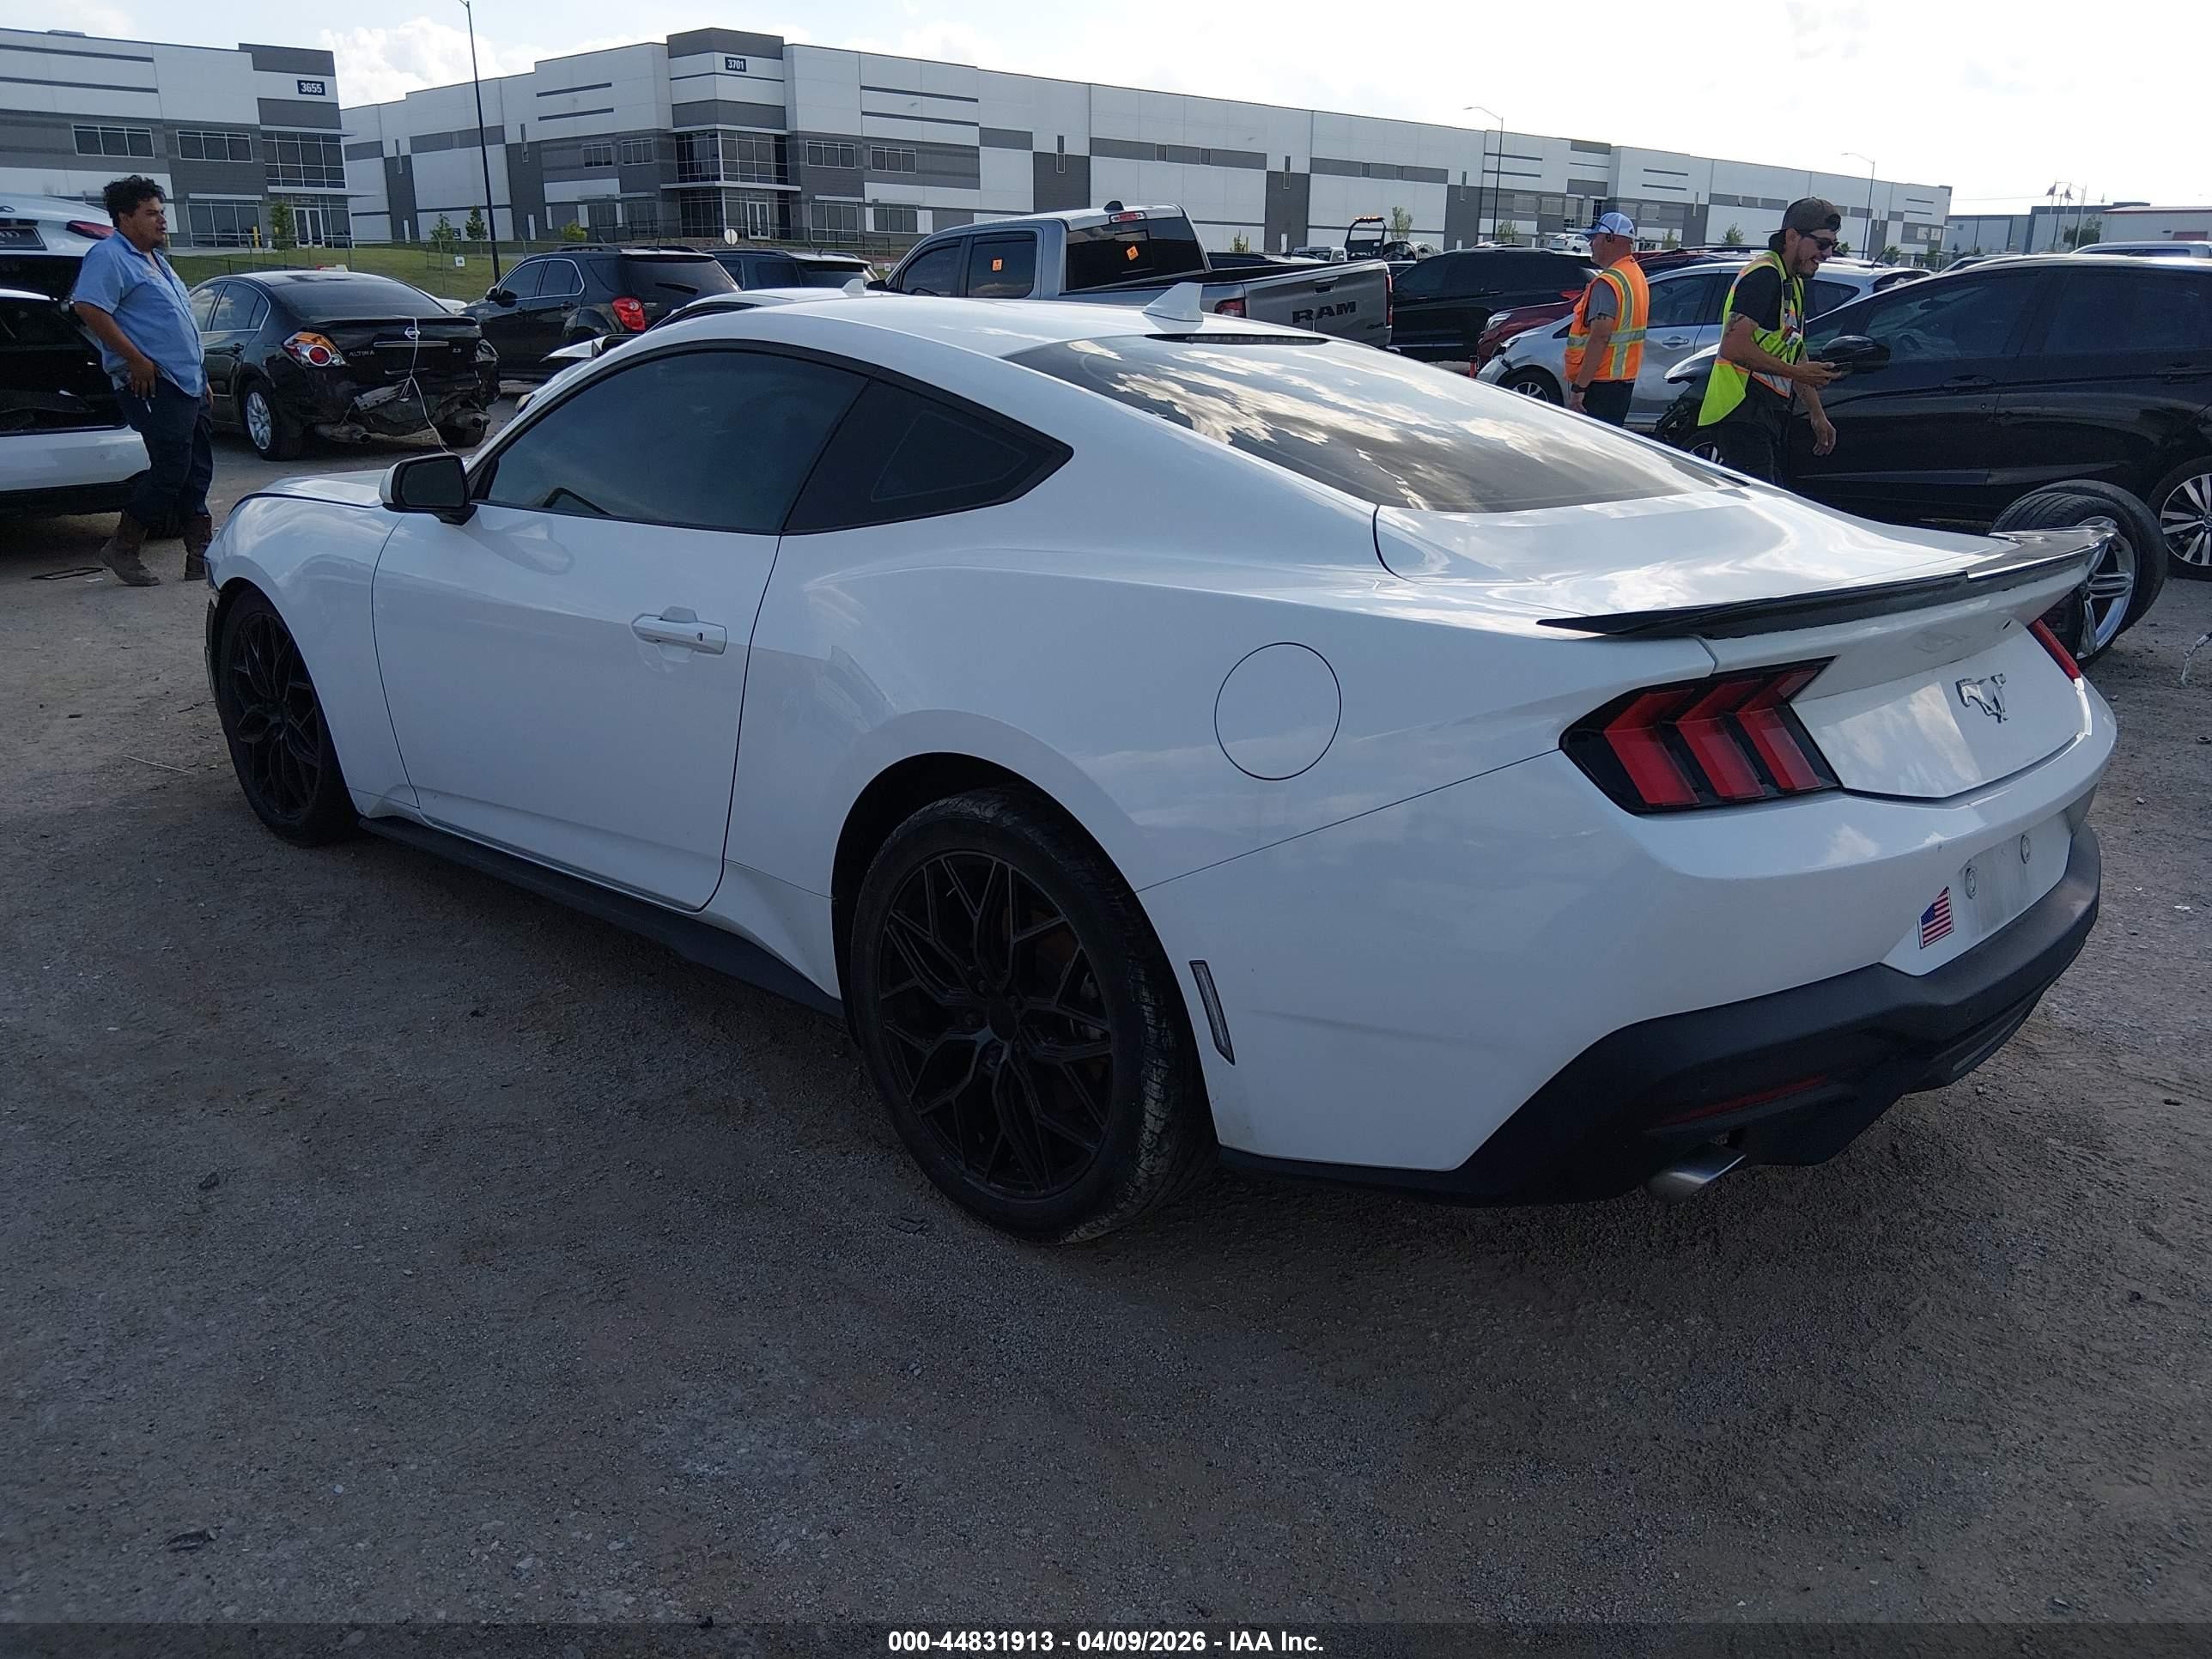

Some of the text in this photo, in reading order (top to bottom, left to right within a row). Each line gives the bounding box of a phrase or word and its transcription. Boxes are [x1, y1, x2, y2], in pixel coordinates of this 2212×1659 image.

[727, 59, 744, 70] 3701
[301, 82, 323, 94] 3655
[1291, 301, 1357, 324] RAM
